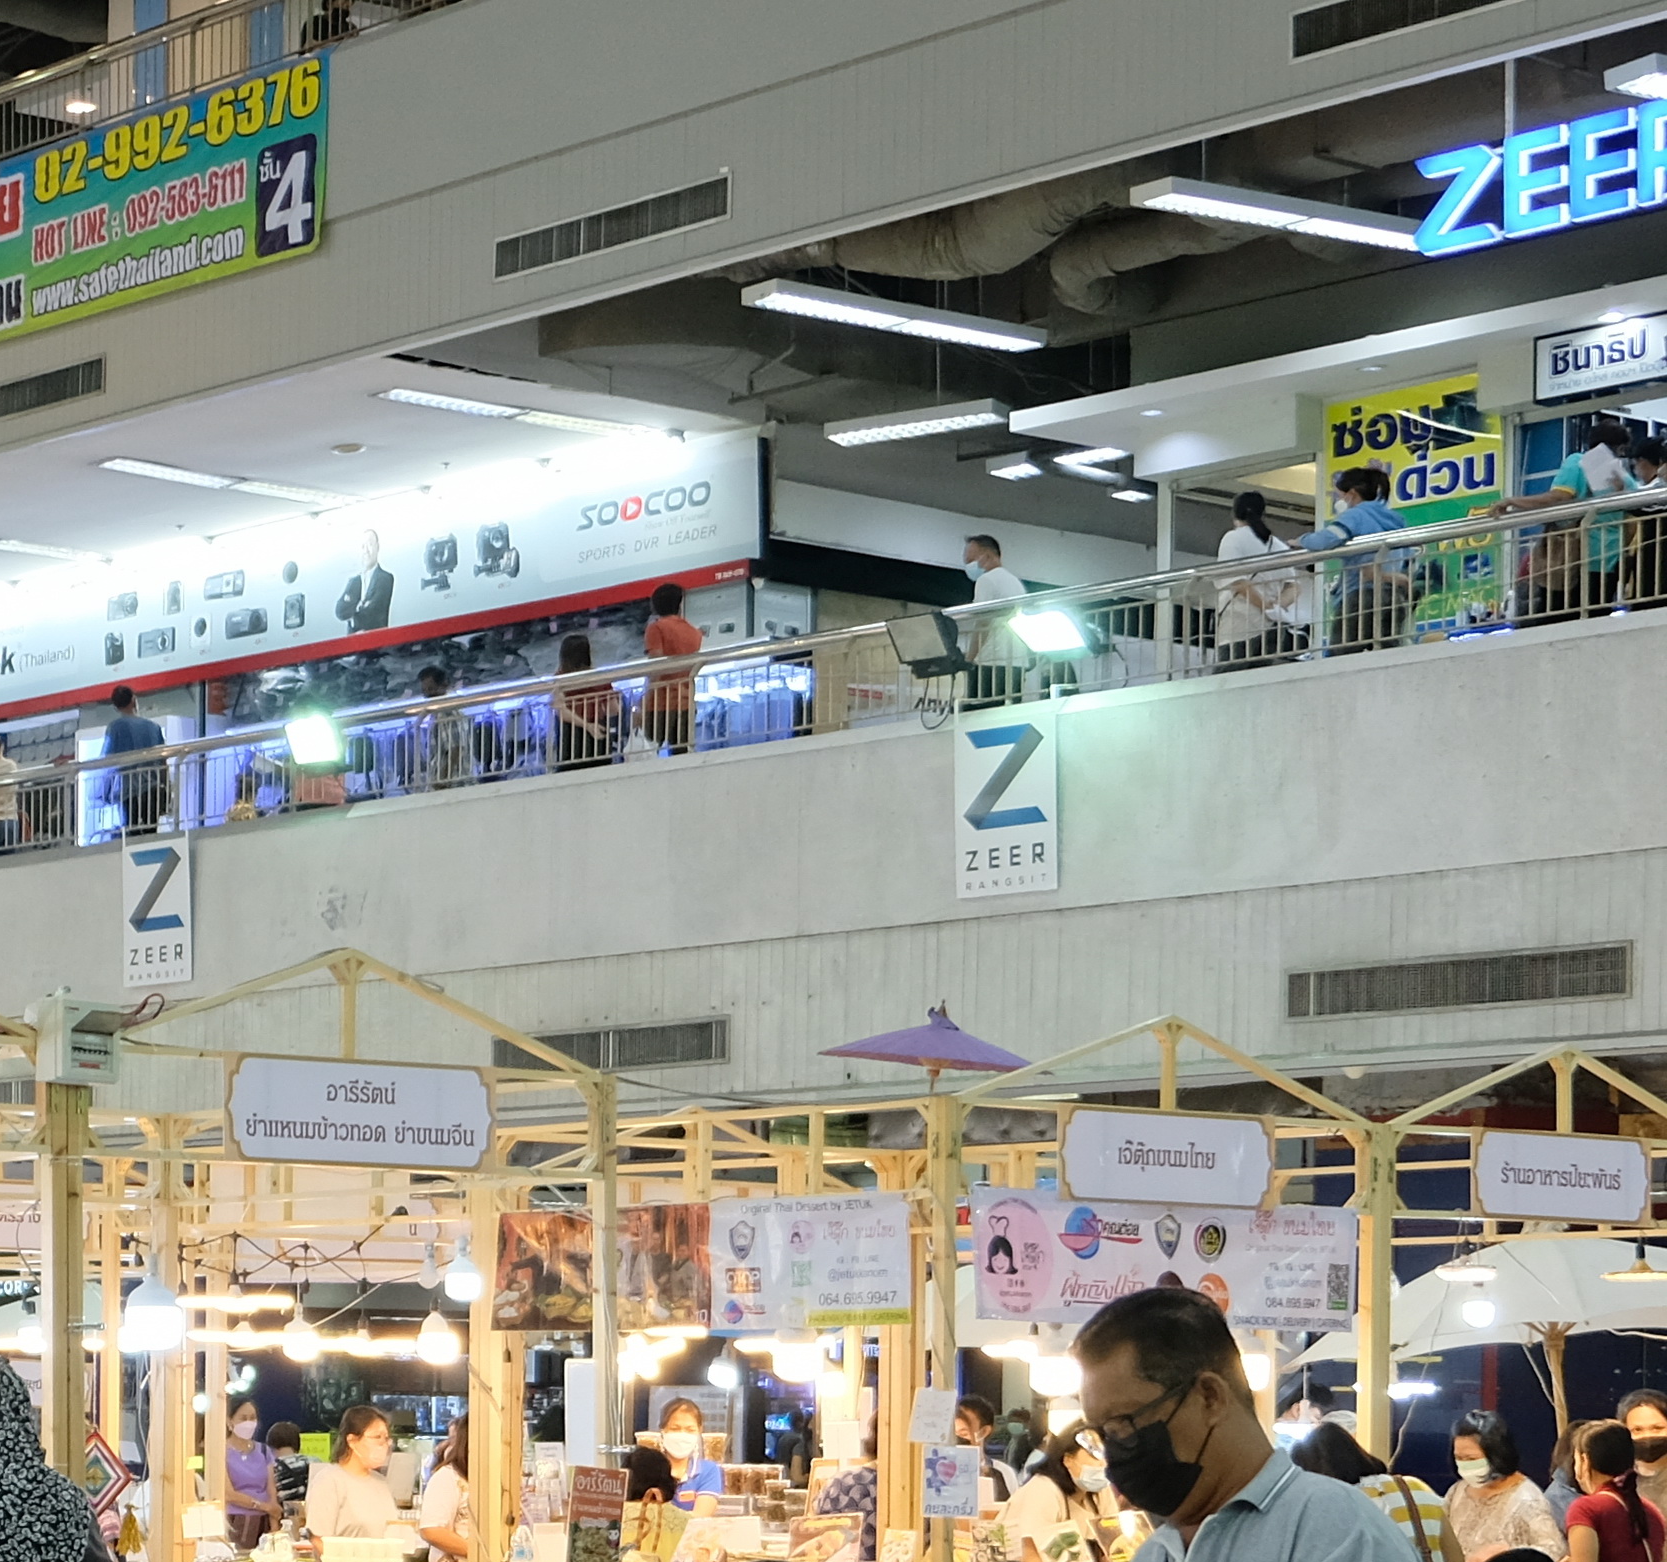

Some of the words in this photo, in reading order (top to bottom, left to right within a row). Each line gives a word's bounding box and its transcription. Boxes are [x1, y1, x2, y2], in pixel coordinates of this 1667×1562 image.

[33, 58, 322, 204] 02-992-6376
[259, 151, 281, 183] ชั้น
[32, 217, 67, 266] HOT
[71, 203, 109, 253] LINE
[123, 158, 248, 237] 092-583-6111
[266, 150, 313, 245] 4
[31, 226, 245, 318] www.safethailand.com
[1396, 450, 1496, 502] ด่วน
[577, 542, 626, 564] SPORTS
[634, 536, 660, 553] DVR
[667, 524, 718, 546] LEADER
[19, 645, 75, 672] (Thailand)
[965, 842, 1046, 872] ZEER
[965, 873, 1047, 892] RANGSIT
[129, 943, 184, 966] ZEER
[325, 1079, 396, 1106] อารีรัตน์
[245, 1112, 386, 1145] ยำแหนมข้าวทอด
[395, 1119, 475, 1148] ยำขนมจีน
[575, 1469, 625, 1495] อารีรัตน์
[924, 1497, 975, 1516] คนละครึ่ง
